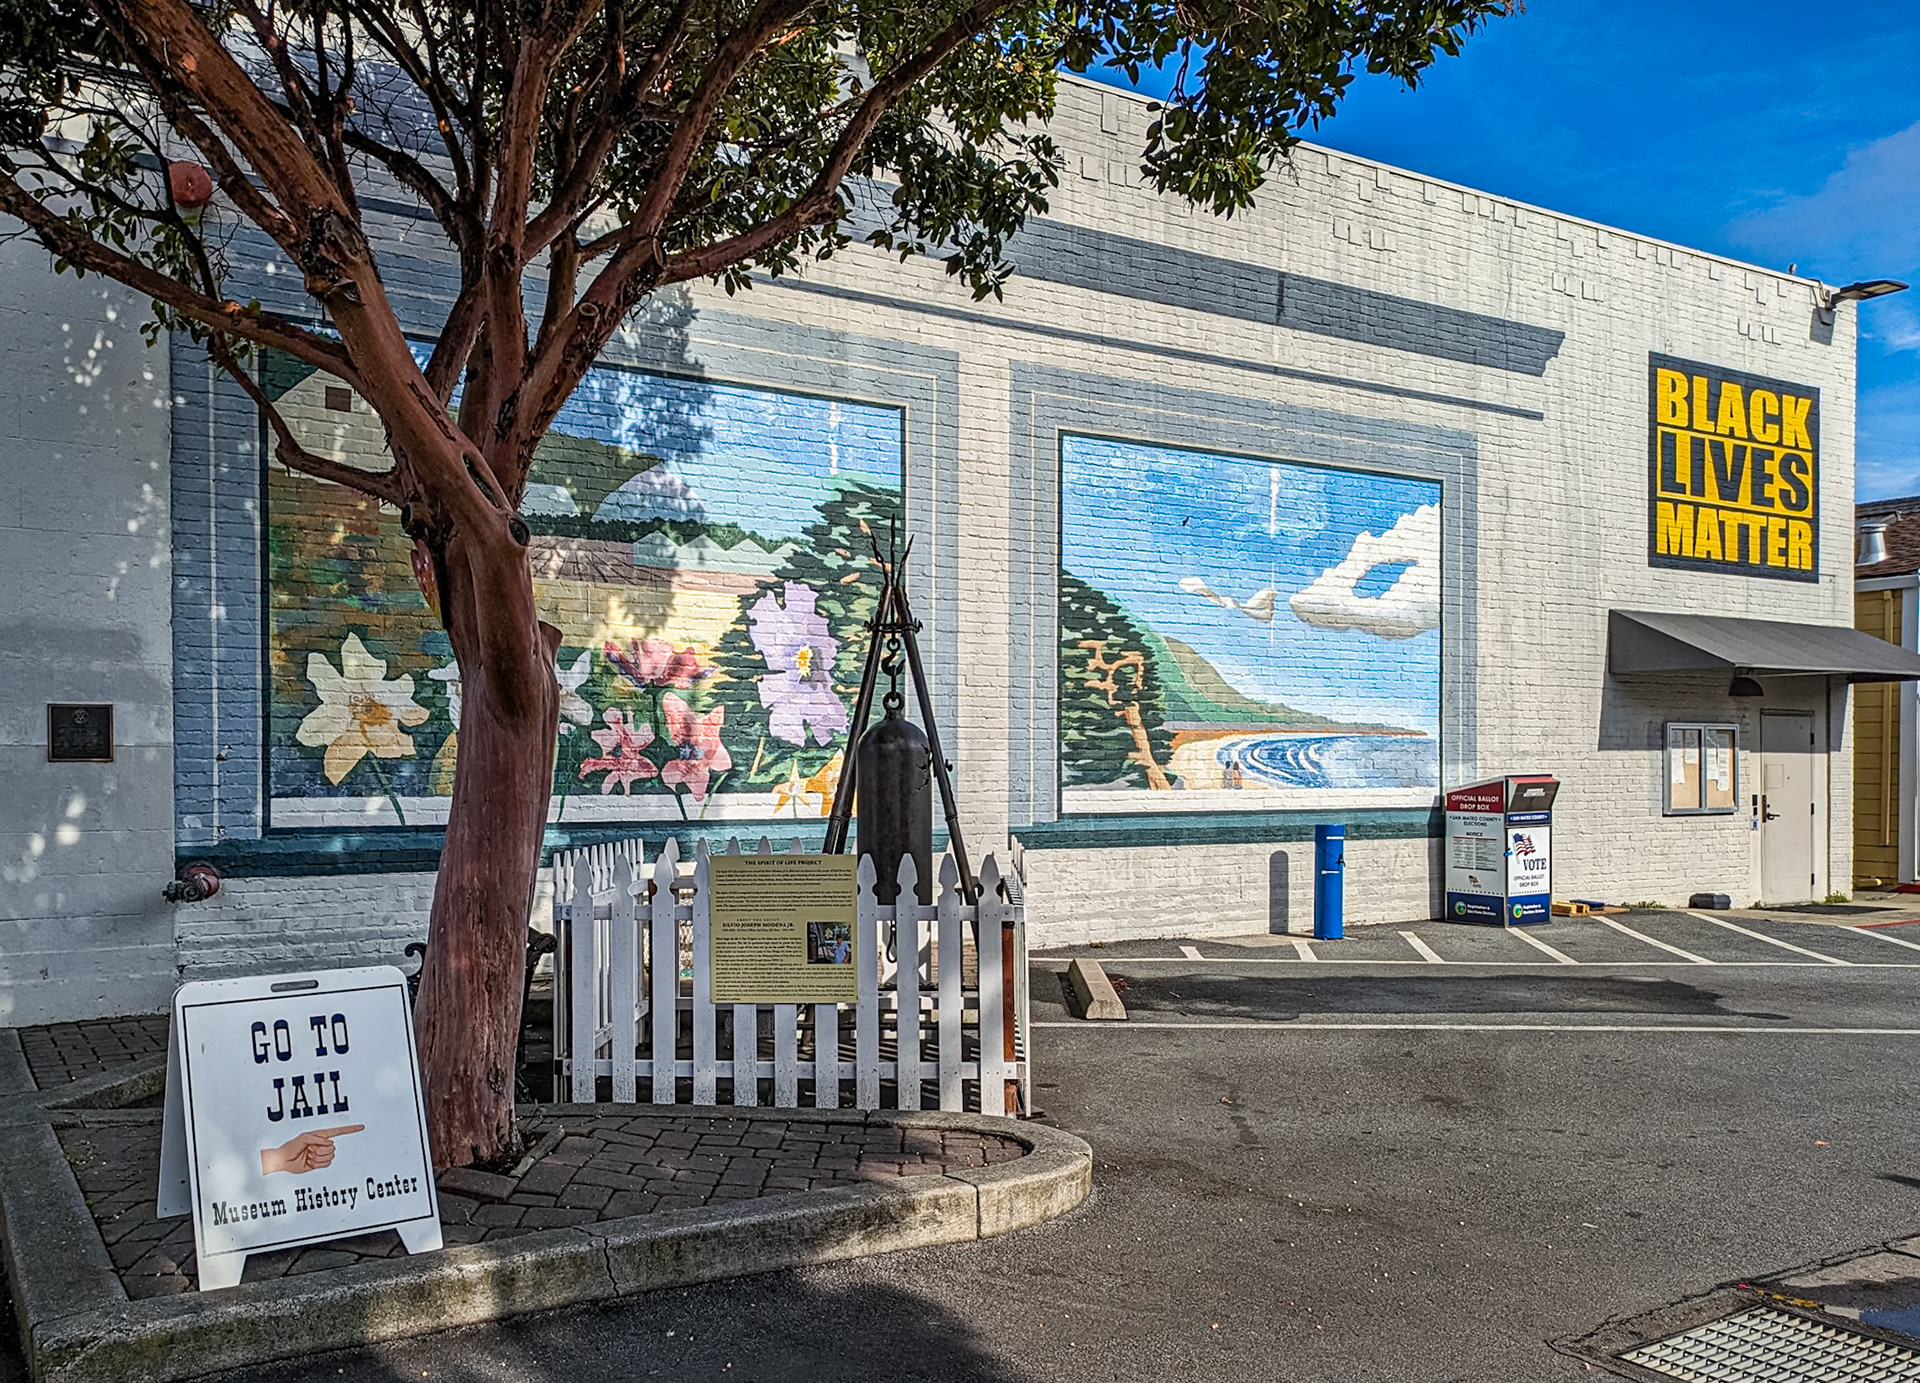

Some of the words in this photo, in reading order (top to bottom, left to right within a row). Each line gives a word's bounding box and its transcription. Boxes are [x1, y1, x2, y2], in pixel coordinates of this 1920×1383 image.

[1656, 367, 1813, 451] BLACK
[1660, 430, 1810, 512] LIVES
[1656, 501, 1812, 571] MATTER
[1523, 858, 1547, 871] VOTE
[250, 1019, 292, 1064] GO
[310, 1013, 350, 1057] TO
[266, 1070, 350, 1123] JAIL
[212, 1199, 287, 1226] Museum
[294, 1186, 358, 1211] History
[365, 1174, 419, 1201] Center
